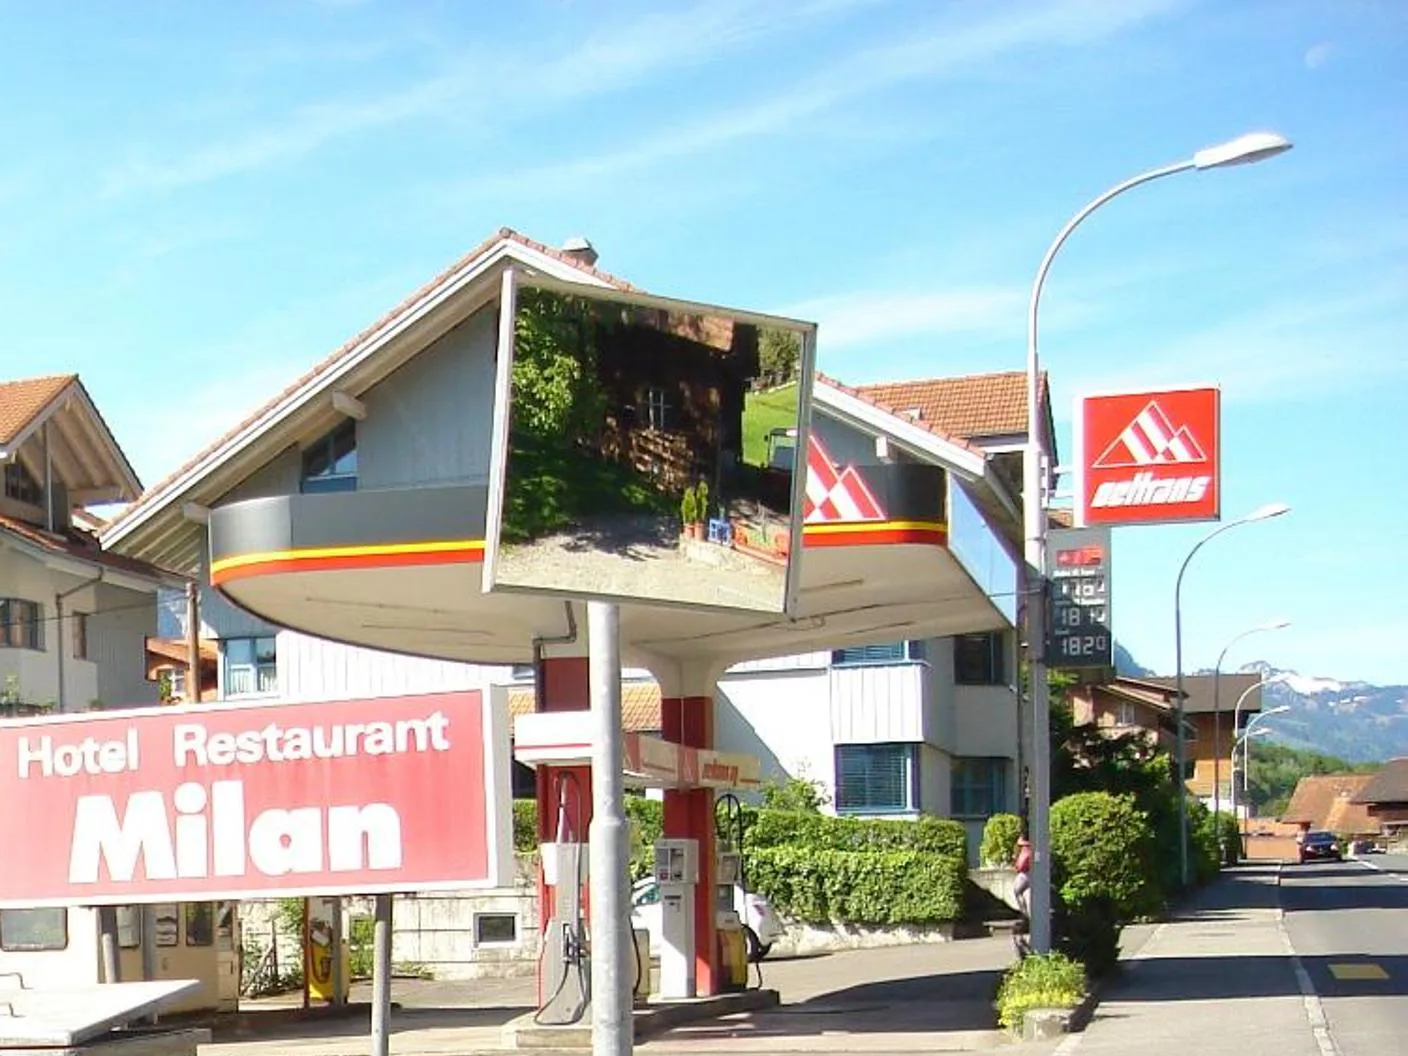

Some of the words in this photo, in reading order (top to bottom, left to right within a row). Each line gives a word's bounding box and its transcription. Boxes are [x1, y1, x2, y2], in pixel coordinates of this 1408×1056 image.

[17, 728, 138, 779] Hotel
[173, 710, 451, 769] Restaurant
[67, 780, 404, 885] Milan
